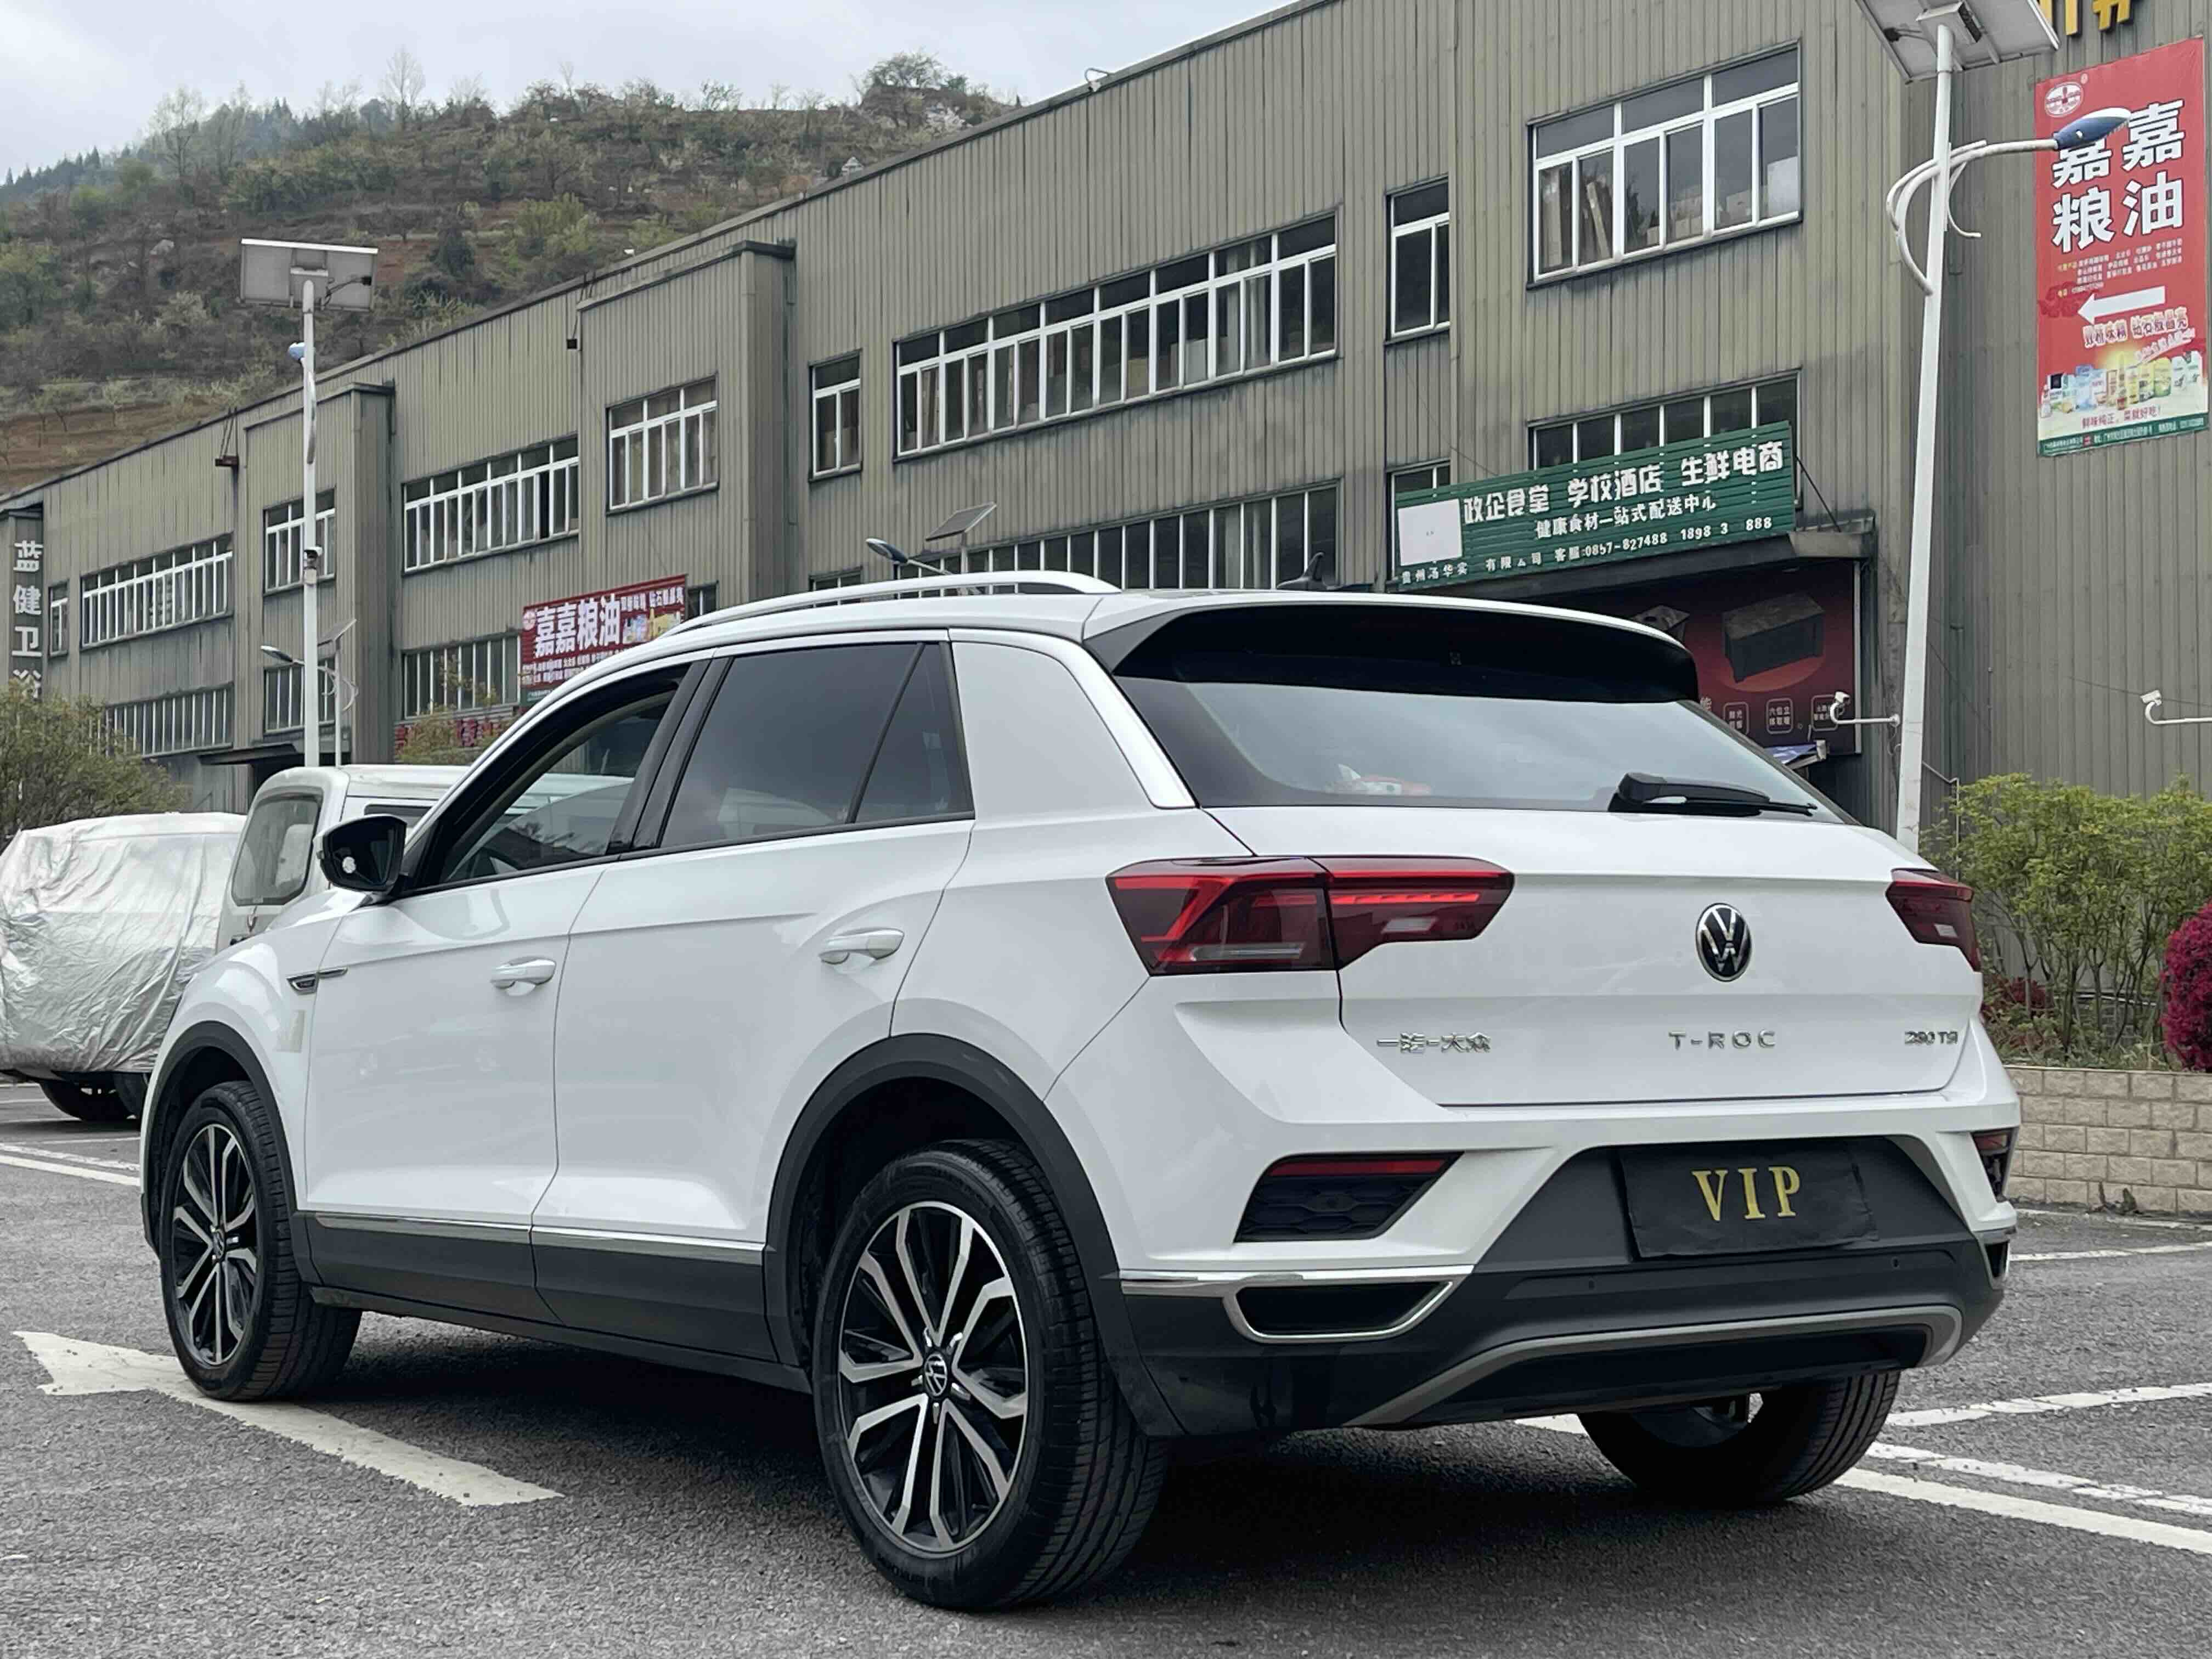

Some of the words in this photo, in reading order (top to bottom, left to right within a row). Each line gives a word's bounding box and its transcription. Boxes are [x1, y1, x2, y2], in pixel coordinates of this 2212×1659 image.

[2051, 171, 2185, 253] 粮油
[1463, 484, 1550, 524] 政企食堂
[1567, 464, 1663, 508] 学校酒店
[1680, 441, 1783, 487] 生鲜电商
[1536, 494, 1717, 539] 健康食材一站式配送中心
[1746, 517, 1772, 532] 888
[534, 592, 622, 658] 嘉嘉粮油
[1668, 1030, 1776, 1051] T-ROC
[1691, 1165, 1801, 1222] VIP
